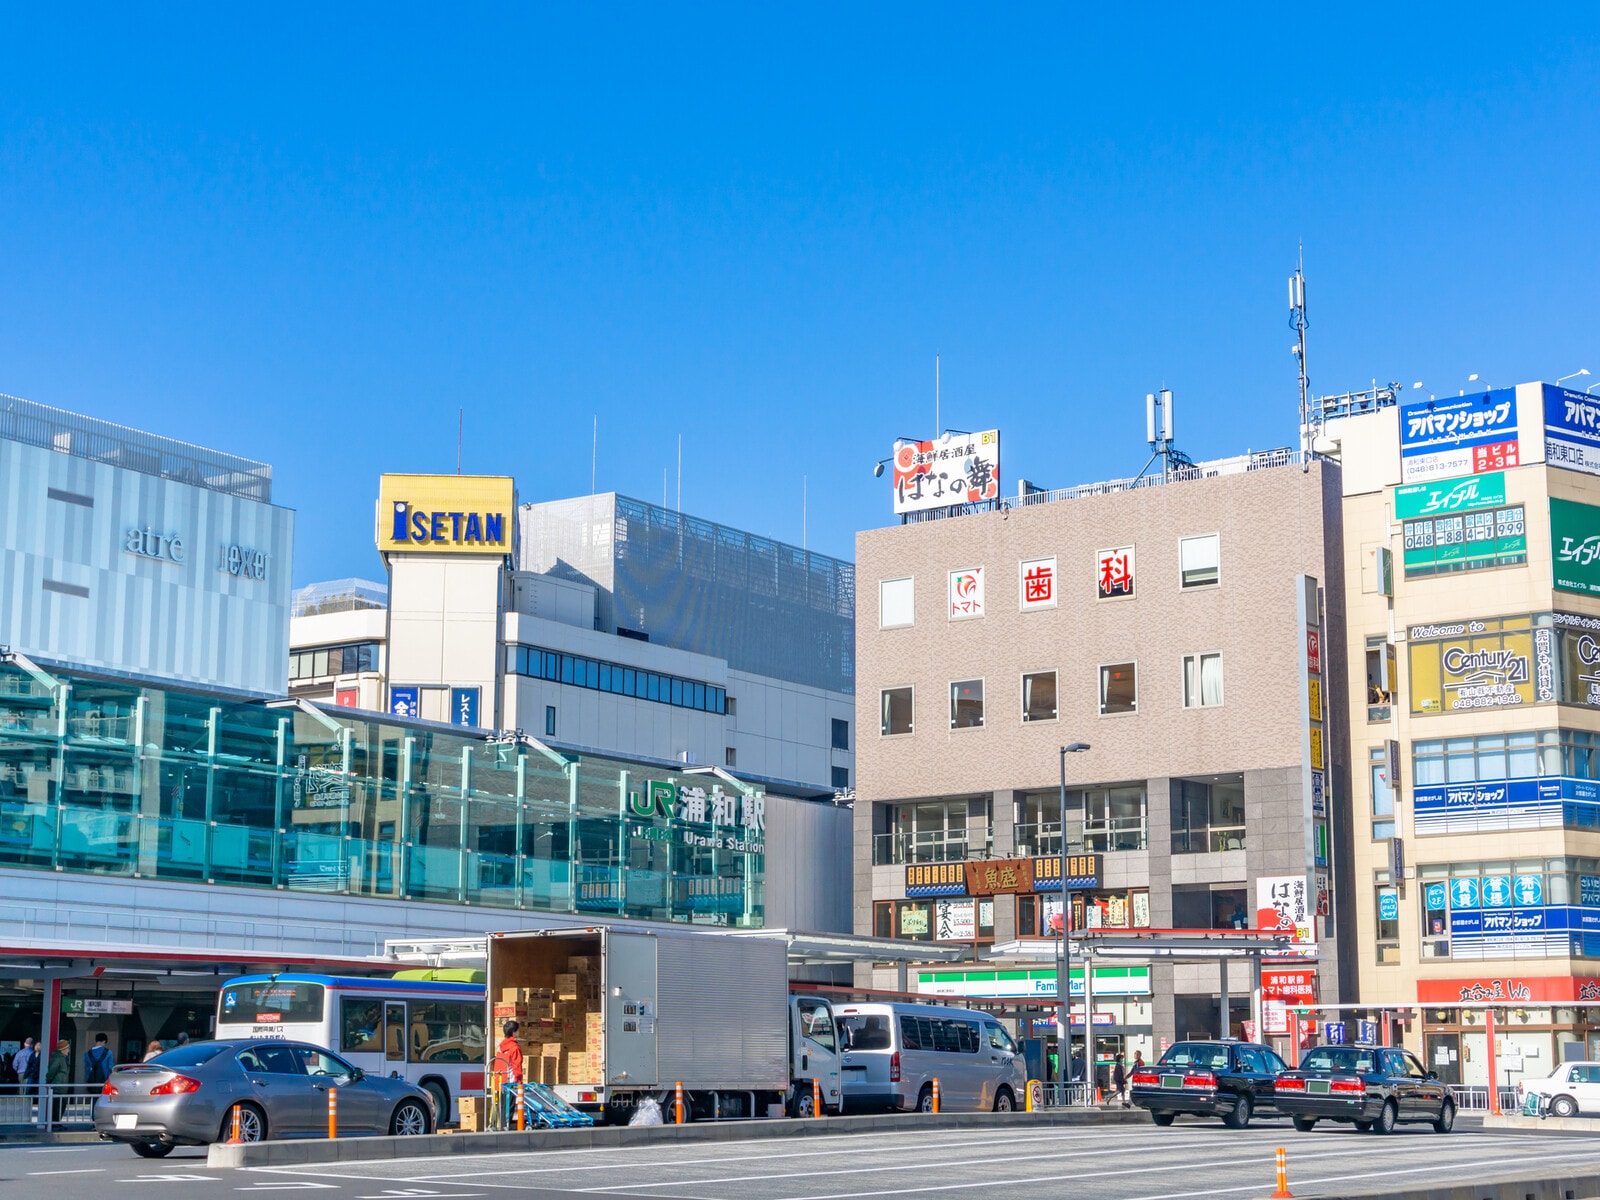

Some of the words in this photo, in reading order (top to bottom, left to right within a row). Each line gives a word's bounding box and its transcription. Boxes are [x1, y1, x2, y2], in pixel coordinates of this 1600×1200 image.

[1408, 401, 1510, 437] アパマンショップ
[981, 432, 996, 445] B1
[913, 444, 977, 464] 海鮮居酒屋
[1477, 443, 1516, 458] 当ビル
[1407, 460, 1468, 474] (048)813-7577
[1420, 478, 1480, 513] エイブル
[390, 501, 502, 541] ISETAN
[1406, 523, 1523, 548] 048-884-1999
[952, 599, 981, 615] トマト
[1412, 624, 1464, 638] Welcome
[1469, 622, 1484, 632] to
[1444, 647, 1513, 673] Century
[1506, 656, 1527, 681] 21
[1453, 695, 1521, 709] 048-882-1948
[1447, 788, 1505, 804] アパマンショップ
[630, 780, 676, 819] JR
[680, 786, 765, 831] 浦和駅
[684, 831, 723, 849] Urawa
[728, 837, 765, 854] Station
[984, 866, 1019, 890] 魚盛
[1294, 880, 1305, 923] 海鮮居酒屋
[936, 899, 953, 938] 宴会
[1484, 914, 1542, 928] アパマンショップ
[1295, 927, 1309, 938] B1
[1035, 980, 1086, 991] FamiMart
[1270, 975, 1304, 985] 浦和駅前
[70, 1000, 83, 1009] JR
